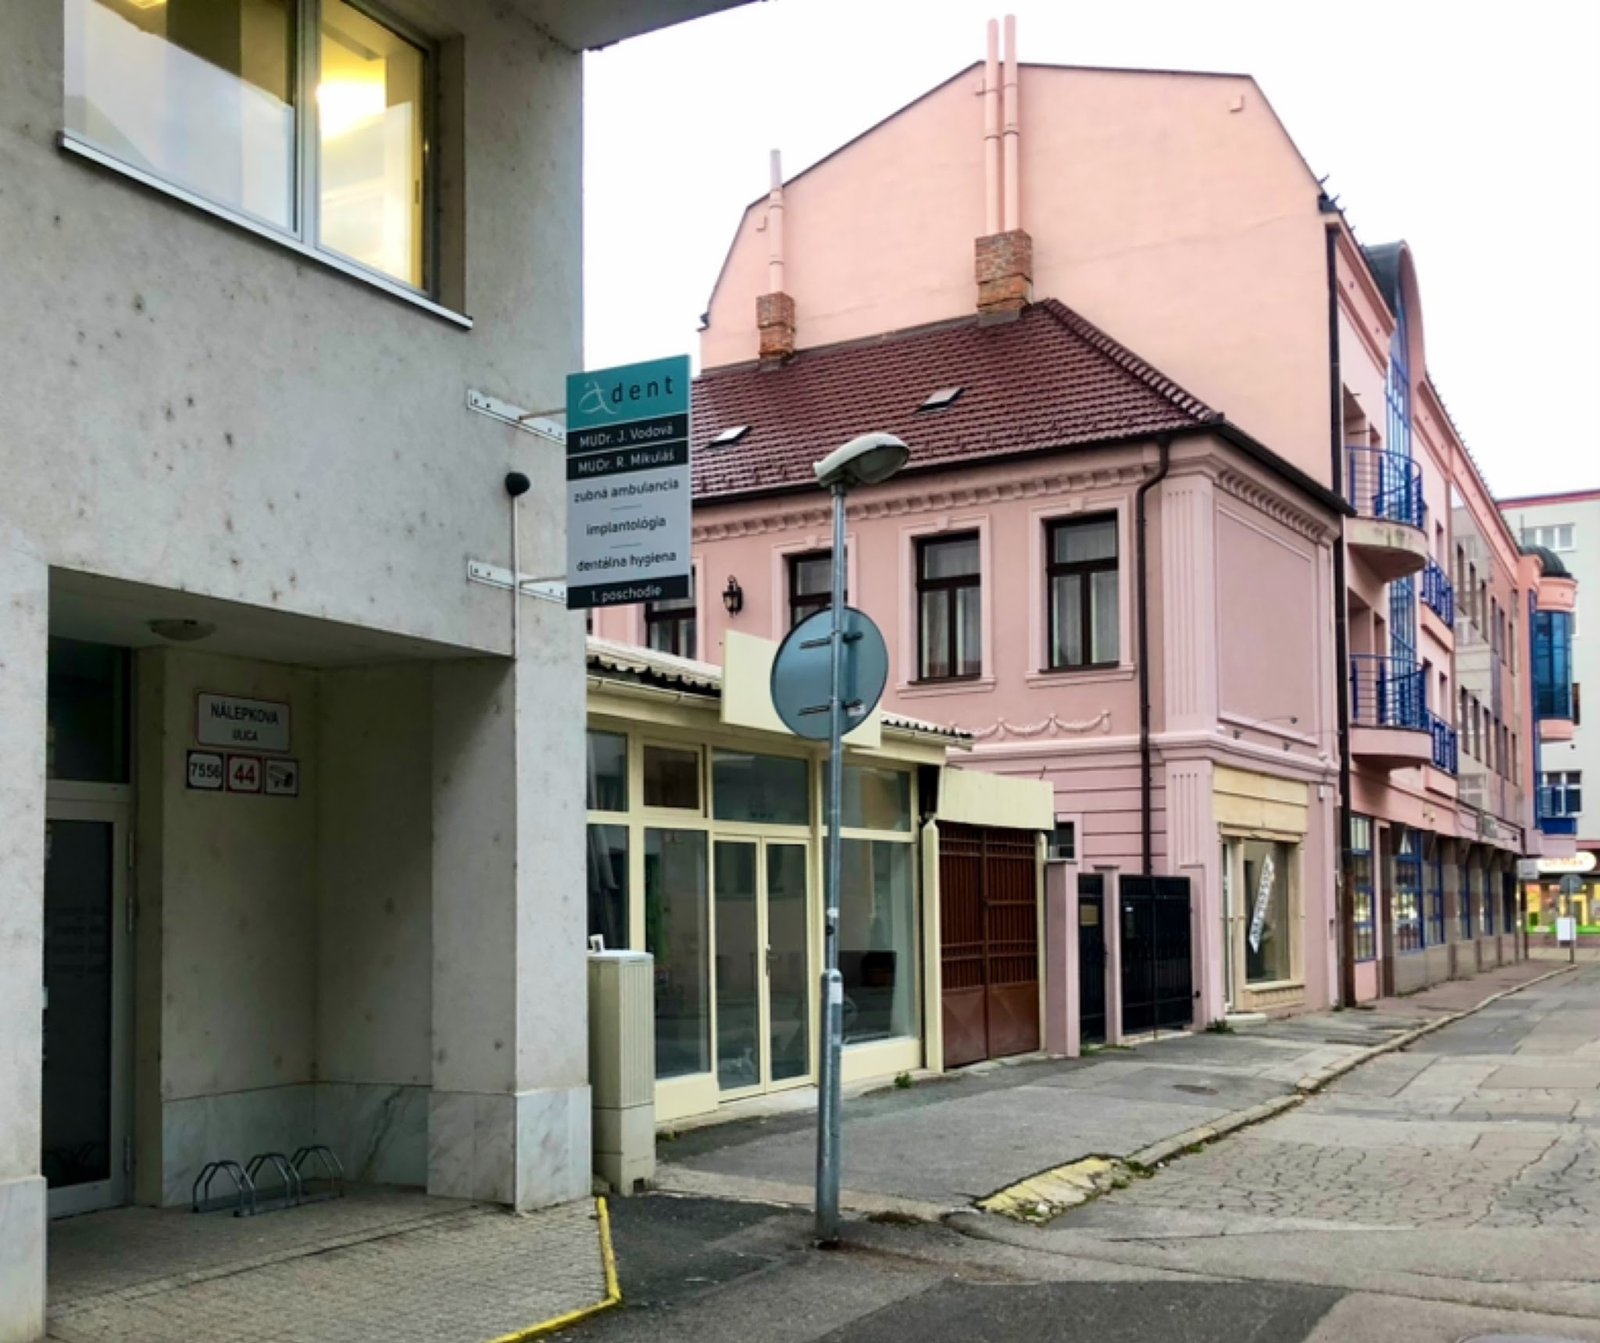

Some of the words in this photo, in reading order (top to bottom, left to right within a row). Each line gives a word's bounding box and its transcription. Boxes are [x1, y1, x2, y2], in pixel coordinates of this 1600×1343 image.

[580, 434, 614, 448] MUDr.
[617, 430, 627, 443] J.
[630, 422, 673, 440] Vodová
[578, 459, 613, 474] MUDr.
[617, 455, 627, 468] R.
[574, 486, 608, 503] zubná
[611, 477, 679, 498] ambulancia
[586, 515, 666, 536] implantológia
[576, 555, 627, 571] dentálna
[630, 551, 677, 568] hygiena
[591, 591, 600, 602] 1.
[602, 584, 662, 603] poschodie
[232, 728, 259, 741] ULICA
[234, 764, 256, 784] 44
